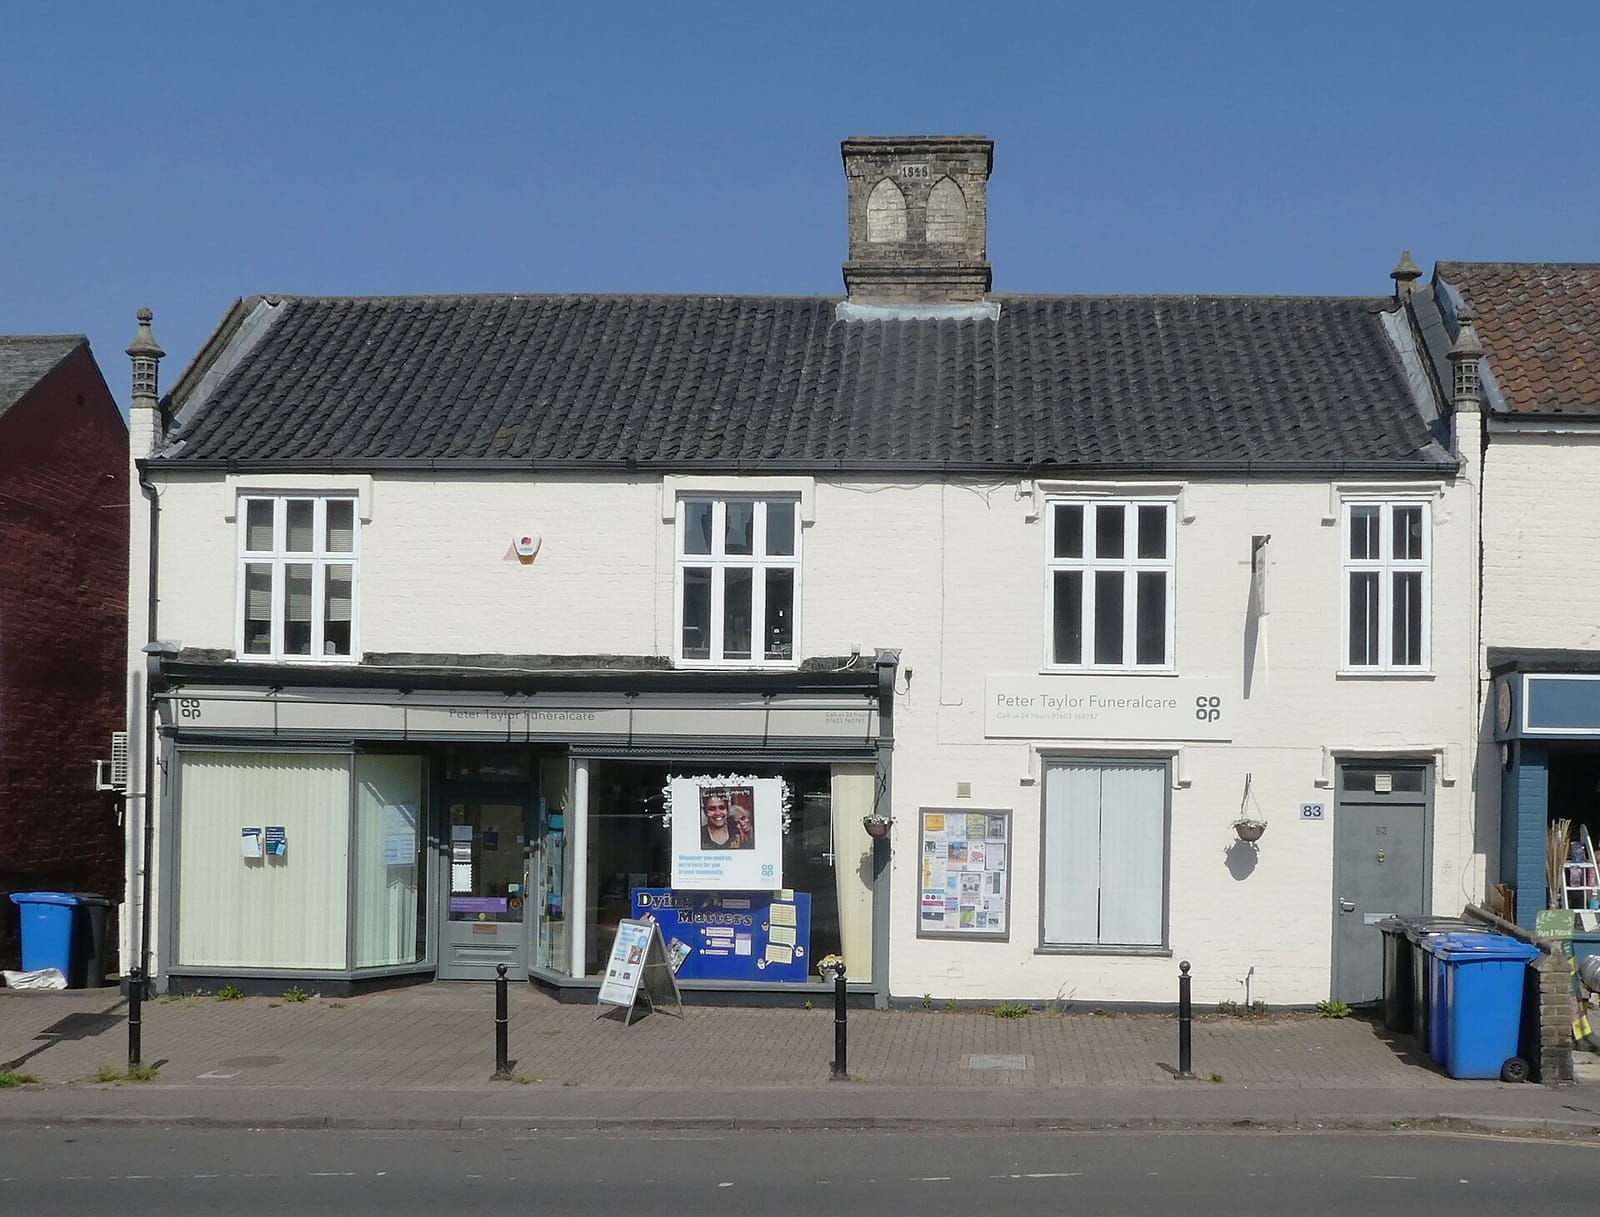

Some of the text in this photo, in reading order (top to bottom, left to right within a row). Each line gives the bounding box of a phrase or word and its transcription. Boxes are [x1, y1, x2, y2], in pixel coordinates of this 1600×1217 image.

[997, 693, 1177, 711] Peter Taylor Funeralcare
[449, 708, 595, 722] Peter Taylor Funeralcare
[1303, 805, 1322, 817] 83
[1376, 826, 1388, 836] 83
[637, 892, 693, 909] Dying
[677, 910, 753, 926] Matters
